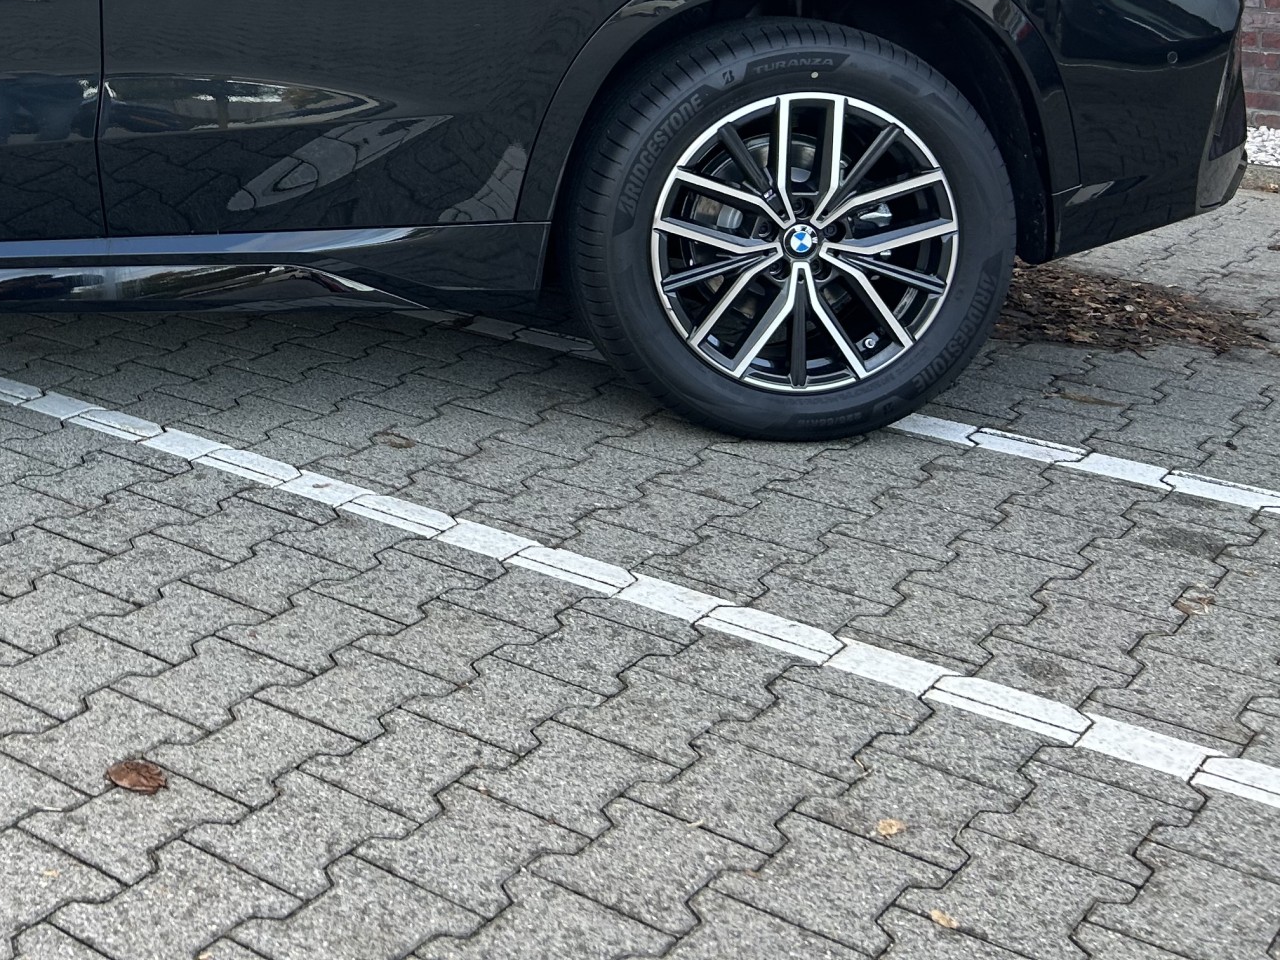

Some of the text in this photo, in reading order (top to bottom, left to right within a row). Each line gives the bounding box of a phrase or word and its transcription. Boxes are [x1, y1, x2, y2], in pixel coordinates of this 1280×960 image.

[753, 57, 834, 74] TURANZA
[618, 93, 705, 217] BRIDGESTONE
[912, 271, 997, 393] BRIDGESTONE
